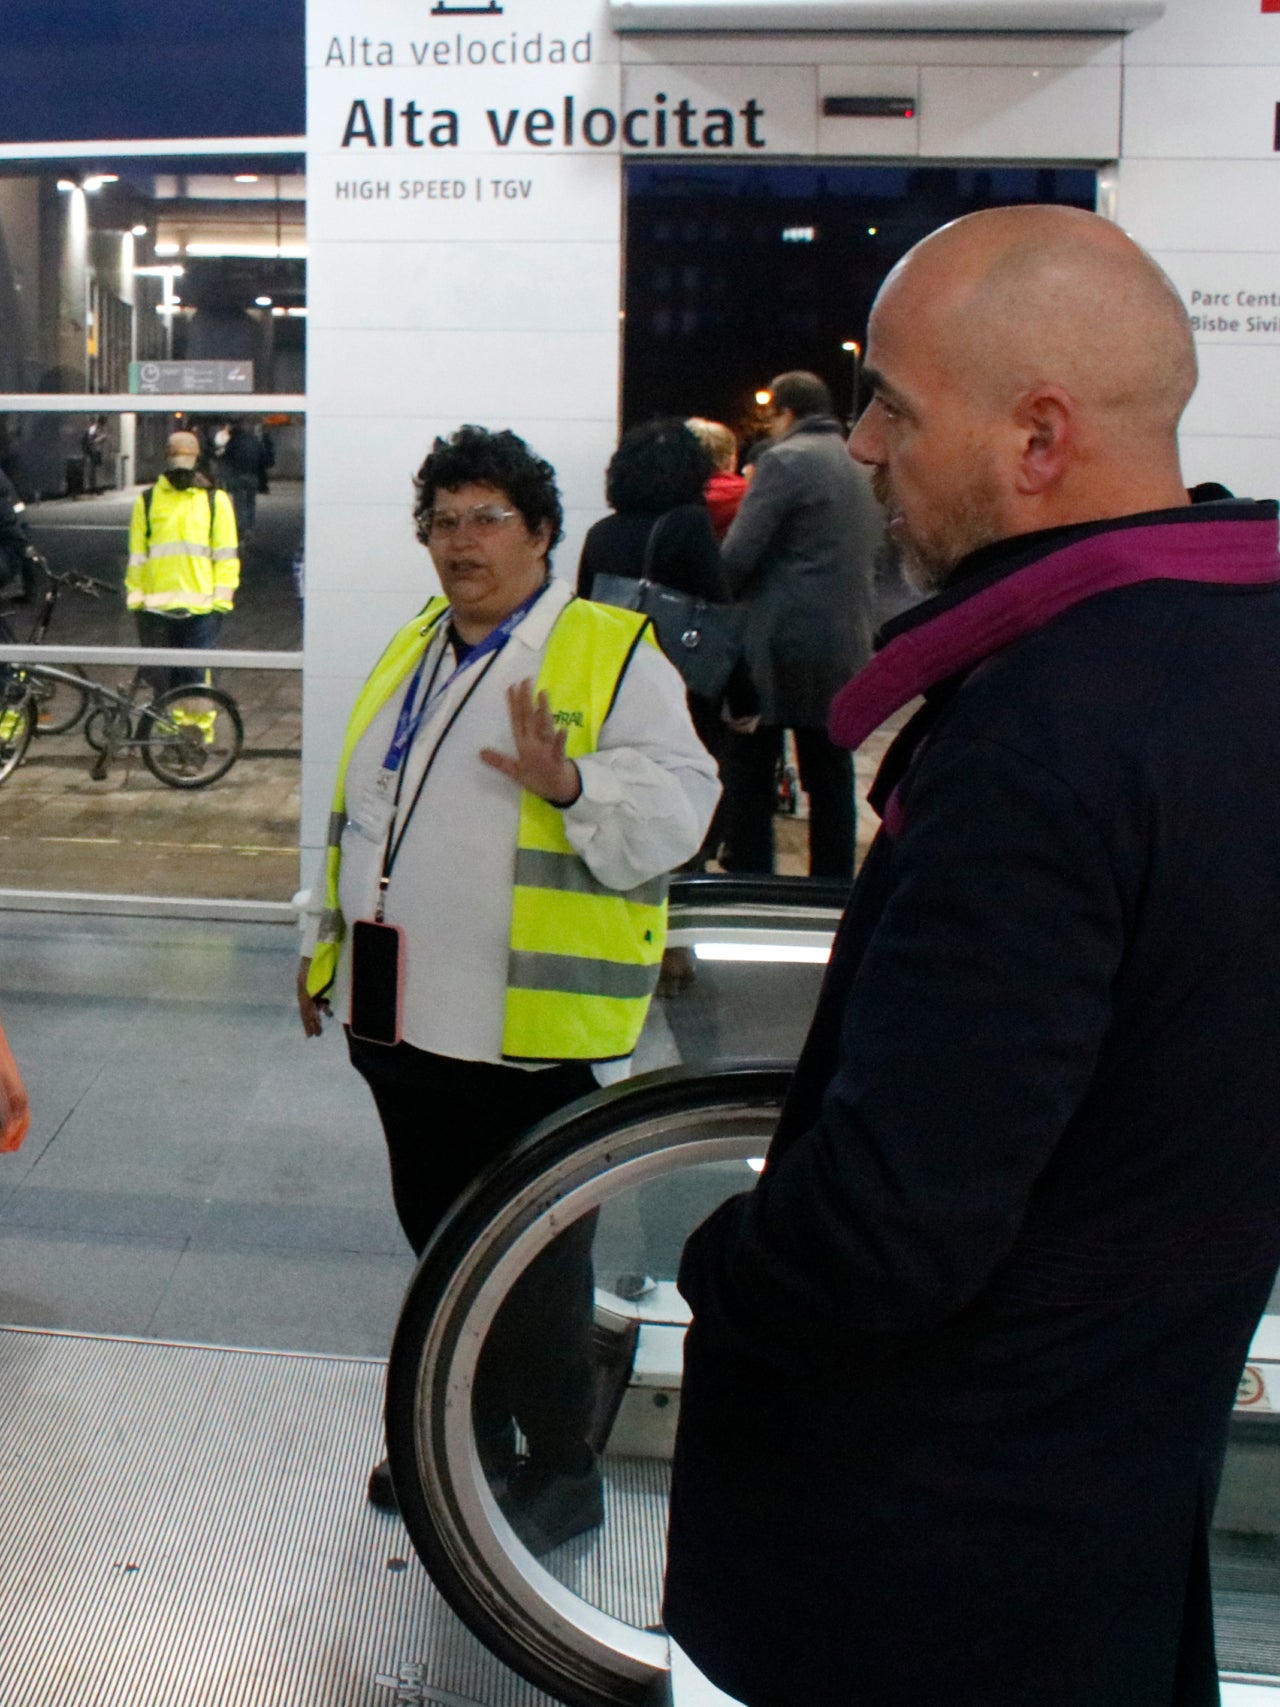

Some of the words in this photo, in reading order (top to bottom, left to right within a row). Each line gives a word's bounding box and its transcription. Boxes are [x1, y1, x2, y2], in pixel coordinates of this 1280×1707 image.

[325, 36, 394, 66] Alta
[410, 32, 592, 65] velocidad
[340, 97, 459, 147] Alta
[485, 92, 766, 147] velocitat
[335, 180, 391, 200] HIGH
[399, 179, 466, 200] SPEED
[489, 178, 533, 199] TGV
[1191, 290, 1231, 306] Parc
[1190, 314, 1239, 332] Bisbe
